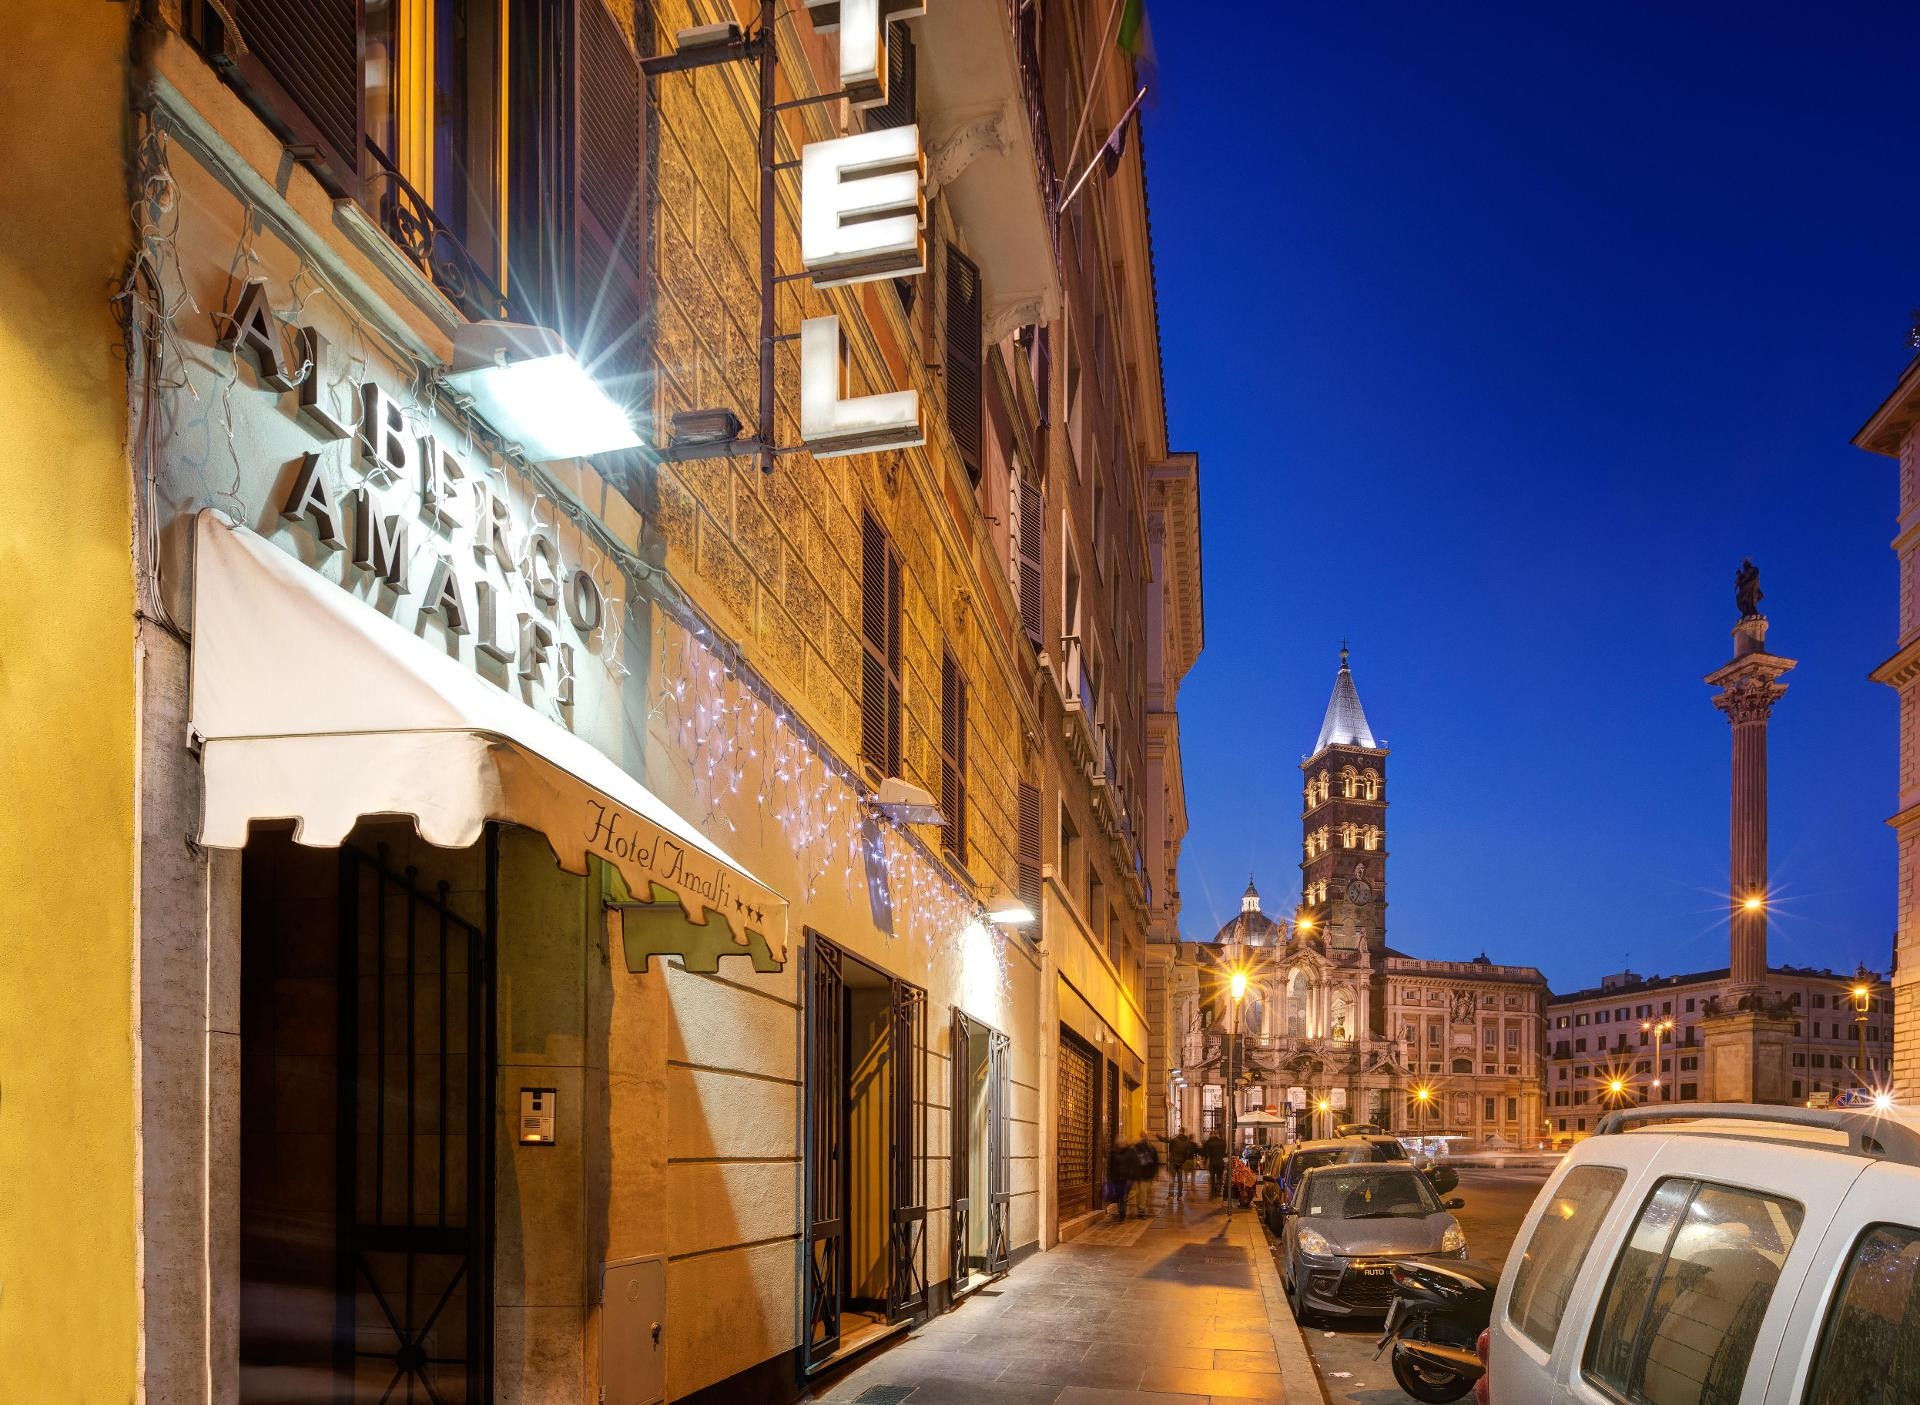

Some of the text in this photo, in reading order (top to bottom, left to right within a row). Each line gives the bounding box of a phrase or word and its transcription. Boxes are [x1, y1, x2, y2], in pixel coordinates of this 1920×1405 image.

[218, 282, 602, 632] ALBERGO
[282, 452, 576, 706] AMALFI
[584, 799, 732, 909] Hotel Amalfi
